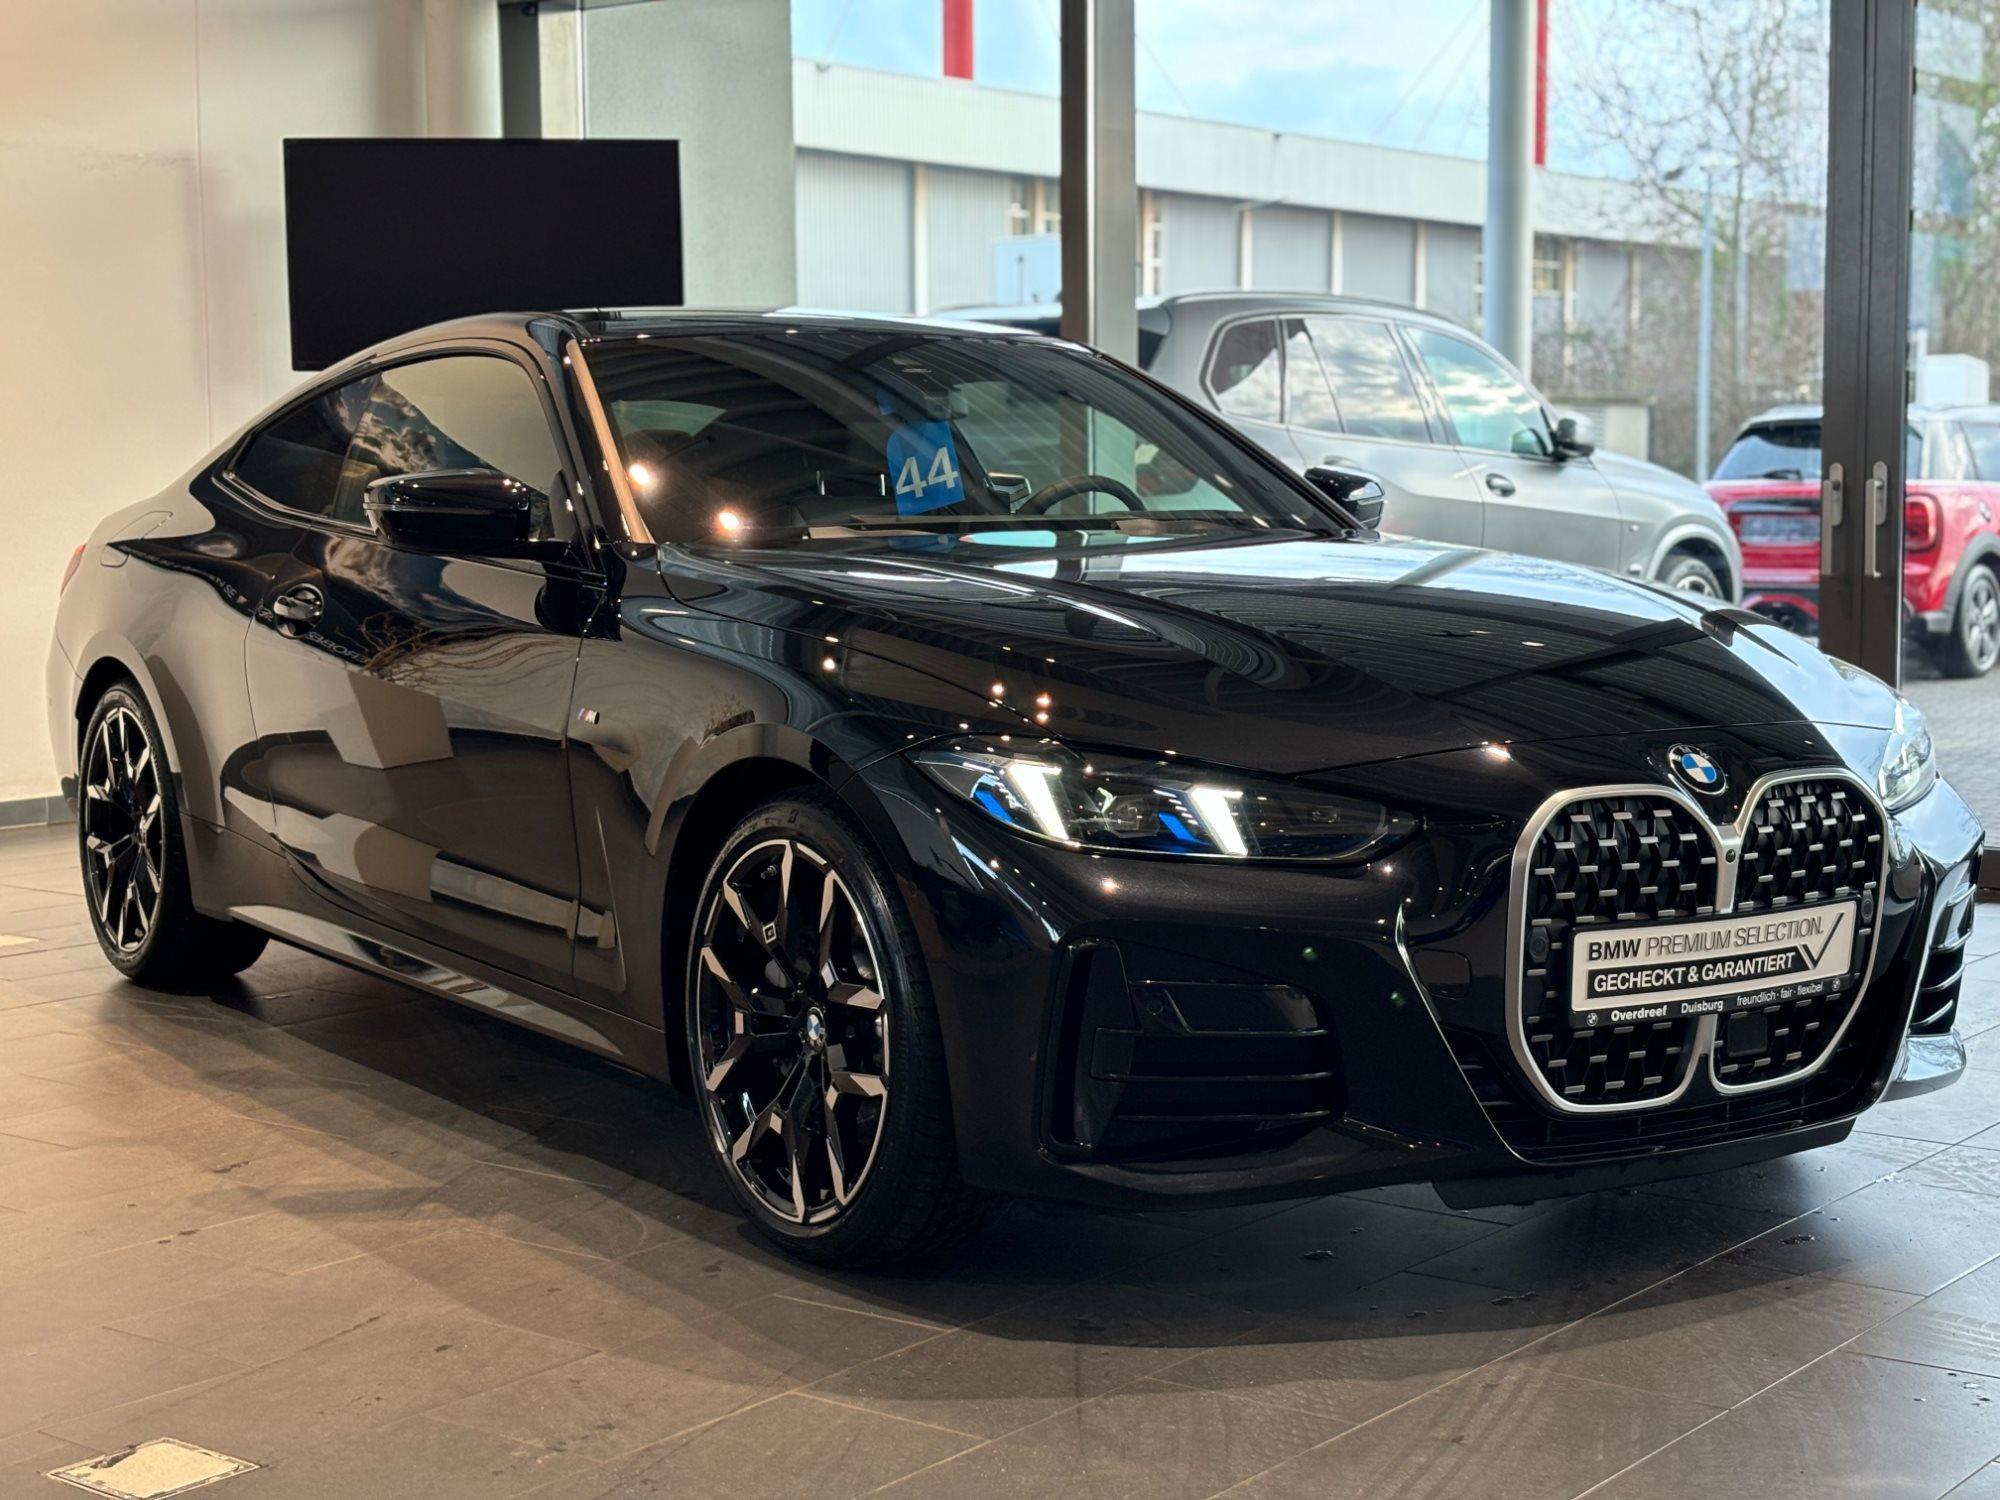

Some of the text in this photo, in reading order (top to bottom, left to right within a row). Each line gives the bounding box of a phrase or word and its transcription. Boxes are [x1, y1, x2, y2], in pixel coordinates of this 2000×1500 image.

[896, 446, 959, 498] 44
[1588, 938, 1641, 961] BMW
[1645, 930, 1731, 957] PREMIUM
[1593, 951, 1796, 992] GECHECKT & GARANTIERT
[1611, 1005, 1668, 1022] Overdreef
[1681, 1000, 1724, 1014] Duisburg
[1736, 991, 1776, 1006] freundlich
[1780, 987, 1793, 999] fair
